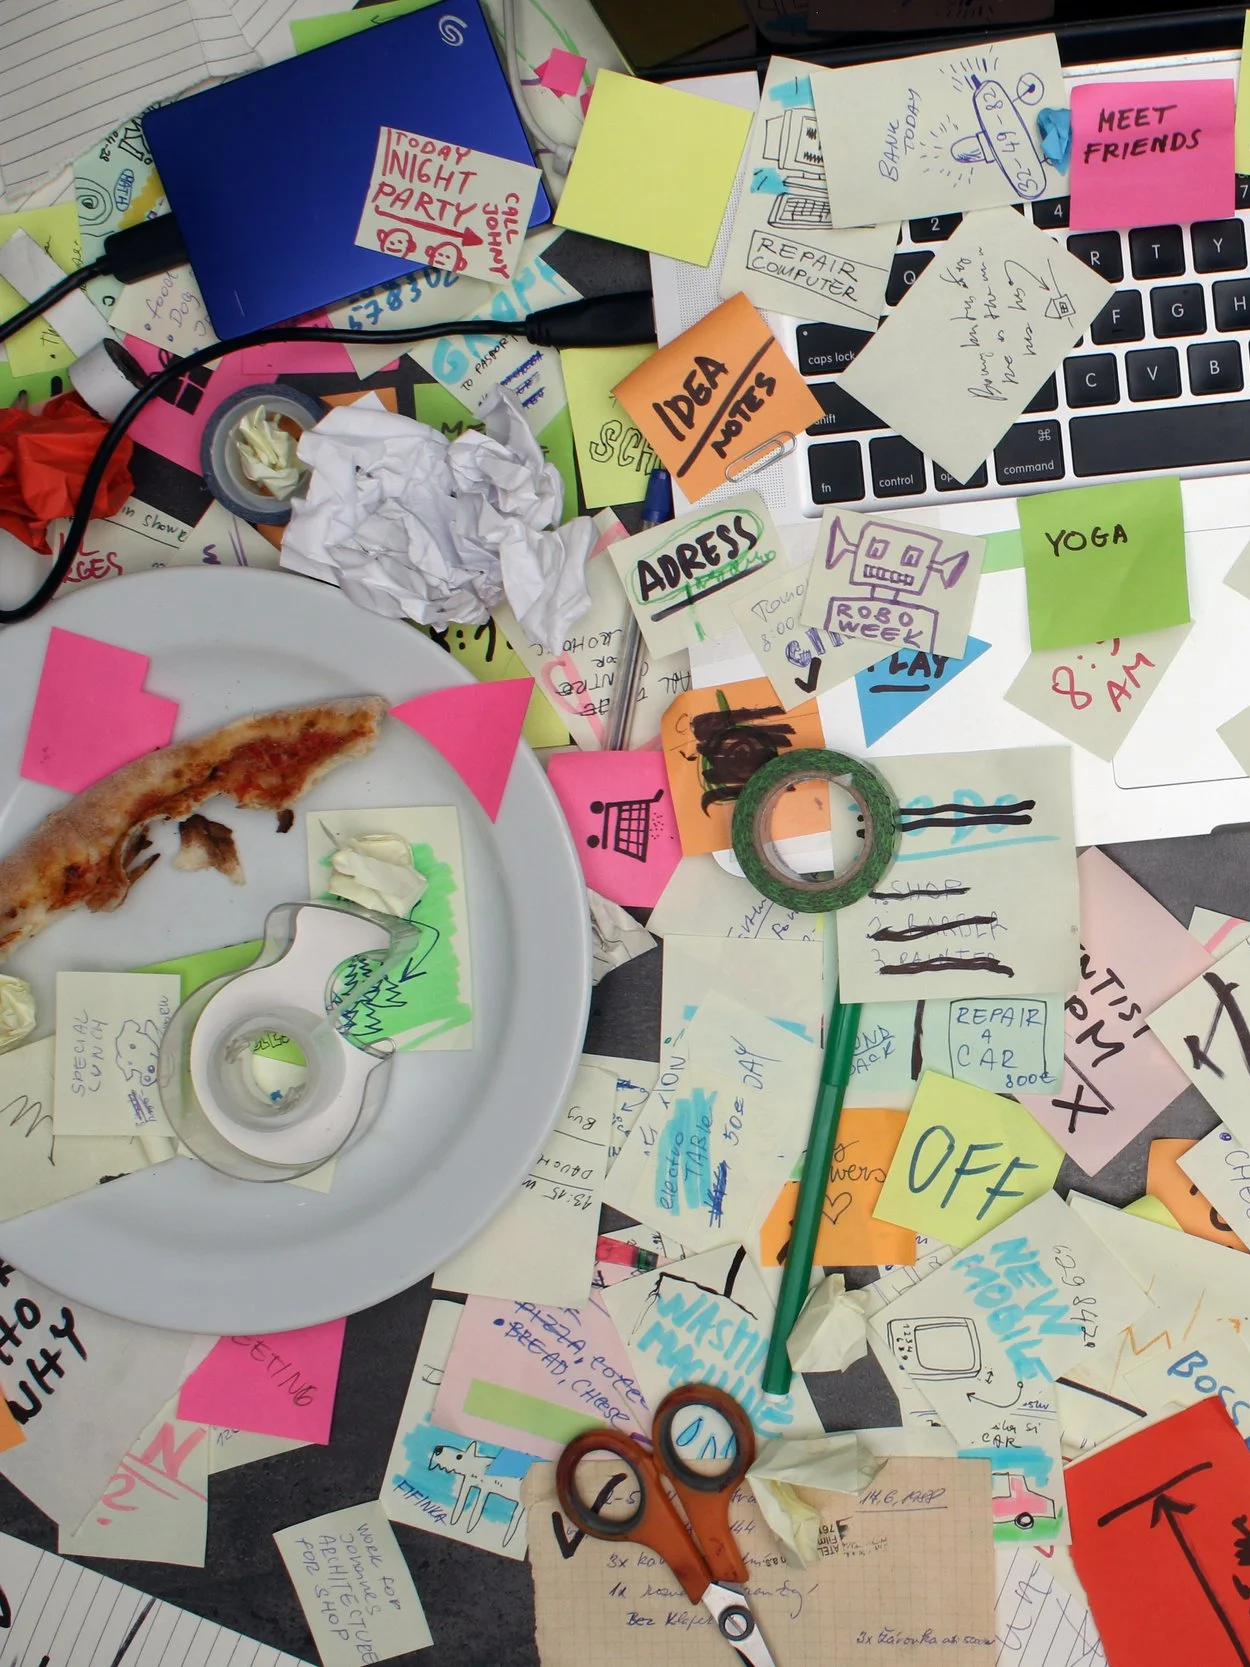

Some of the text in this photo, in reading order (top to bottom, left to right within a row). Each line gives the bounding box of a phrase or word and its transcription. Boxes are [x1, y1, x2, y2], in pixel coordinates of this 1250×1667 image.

[904, 88, 922, 155] TODAY
[1098, 104, 1178, 133] MEET
[396, 131, 472, 165] TODAY
[878, 119, 900, 183] BANK
[1083, 129, 1202, 164] FRIENDS
[389, 149, 477, 195] NIGHT
[371, 181, 478, 227] PARTY
[1239, 185, 1249, 199] 7
[501, 192, 520, 244] CALL
[930, 217, 941, 231] 2
[1053, 203, 1063, 219] 4
[482, 203, 510, 279] JOHNY
[1151, 244, 1161, 259] T
[1213, 237, 1223, 253] Y
[759, 237, 859, 284] REPAIR
[1090, 250, 1101, 266] R
[751, 256, 859, 302] COMPUTER
[903, 270, 916, 285] Q
[1112, 309, 1121, 324] F
[1171, 302, 1184, 318] G
[1234, 296, 1247, 312] H
[808, 353, 833, 366] caps
[1211, 359, 1220, 375] B
[460, 378, 474, 392] TO
[1085, 372, 1097, 388] C
[1147, 366, 1158, 382] V
[652, 355, 730, 442] IDEA
[710, 371, 777, 459] NOTES
[1003, 458, 1055, 475] command
[821, 482, 832, 494] fn
[878, 473, 914, 488] control
[1045, 523, 1128, 557] YOGA
[637, 515, 757, 602] ADRESS
[836, 602, 915, 628] ROBO
[837, 619, 924, 649] WEEK
[1106, 652, 1156, 713] AM
[956, 1006, 1045, 1026] REPAIR
[981, 1028, 992, 1040] A
[70, 1009, 89, 1098] SPECIAL
[957, 1043, 1018, 1069] CAR
[908, 1124, 1039, 1221] OFF
[989, 1236, 1083, 1336] NEW
[231, 1335, 318, 1408] EETING
[817, 1543, 839, 1557] ATEL
